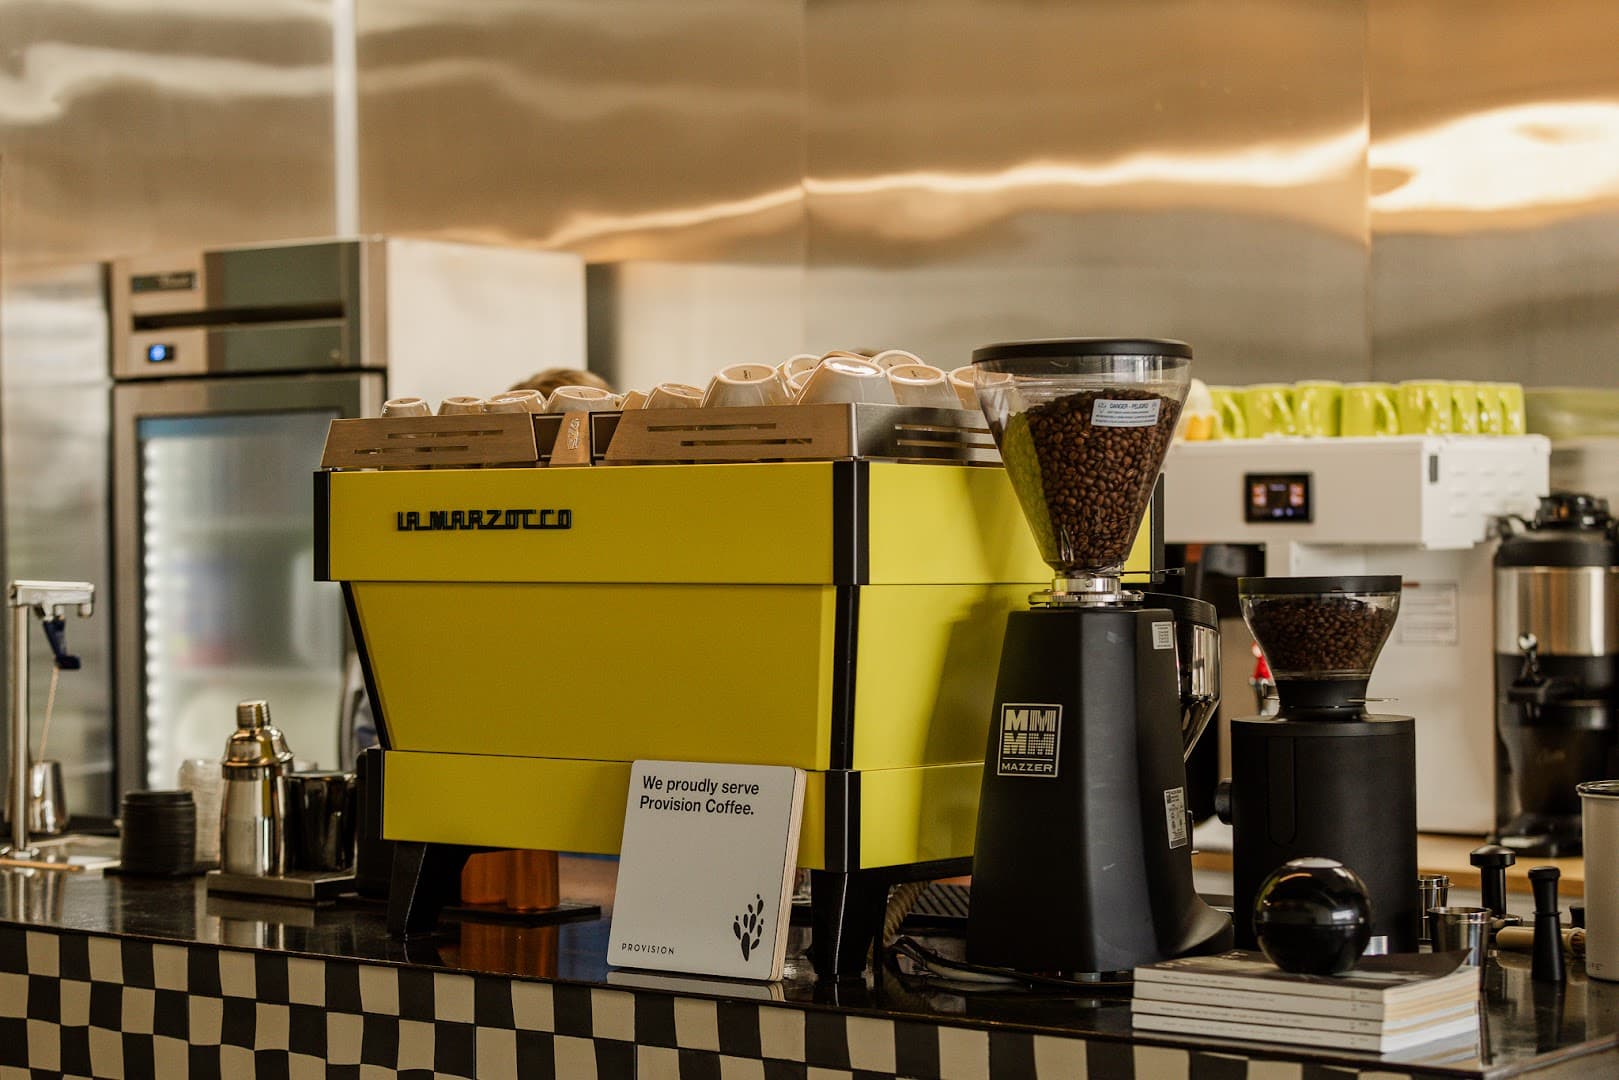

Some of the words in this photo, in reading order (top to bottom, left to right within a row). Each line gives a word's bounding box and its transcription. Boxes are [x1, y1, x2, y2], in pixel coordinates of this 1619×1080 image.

[397, 511, 420, 531] LA
[1001, 763, 1053, 773] MAZZER
[643, 775, 663, 790] We
[666, 778, 719, 796] proudly
[721, 782, 760, 795] serve
[639, 795, 701, 813] Provision
[705, 798, 754, 816] Coffee.
[621, 942, 675, 955] PROVISION
